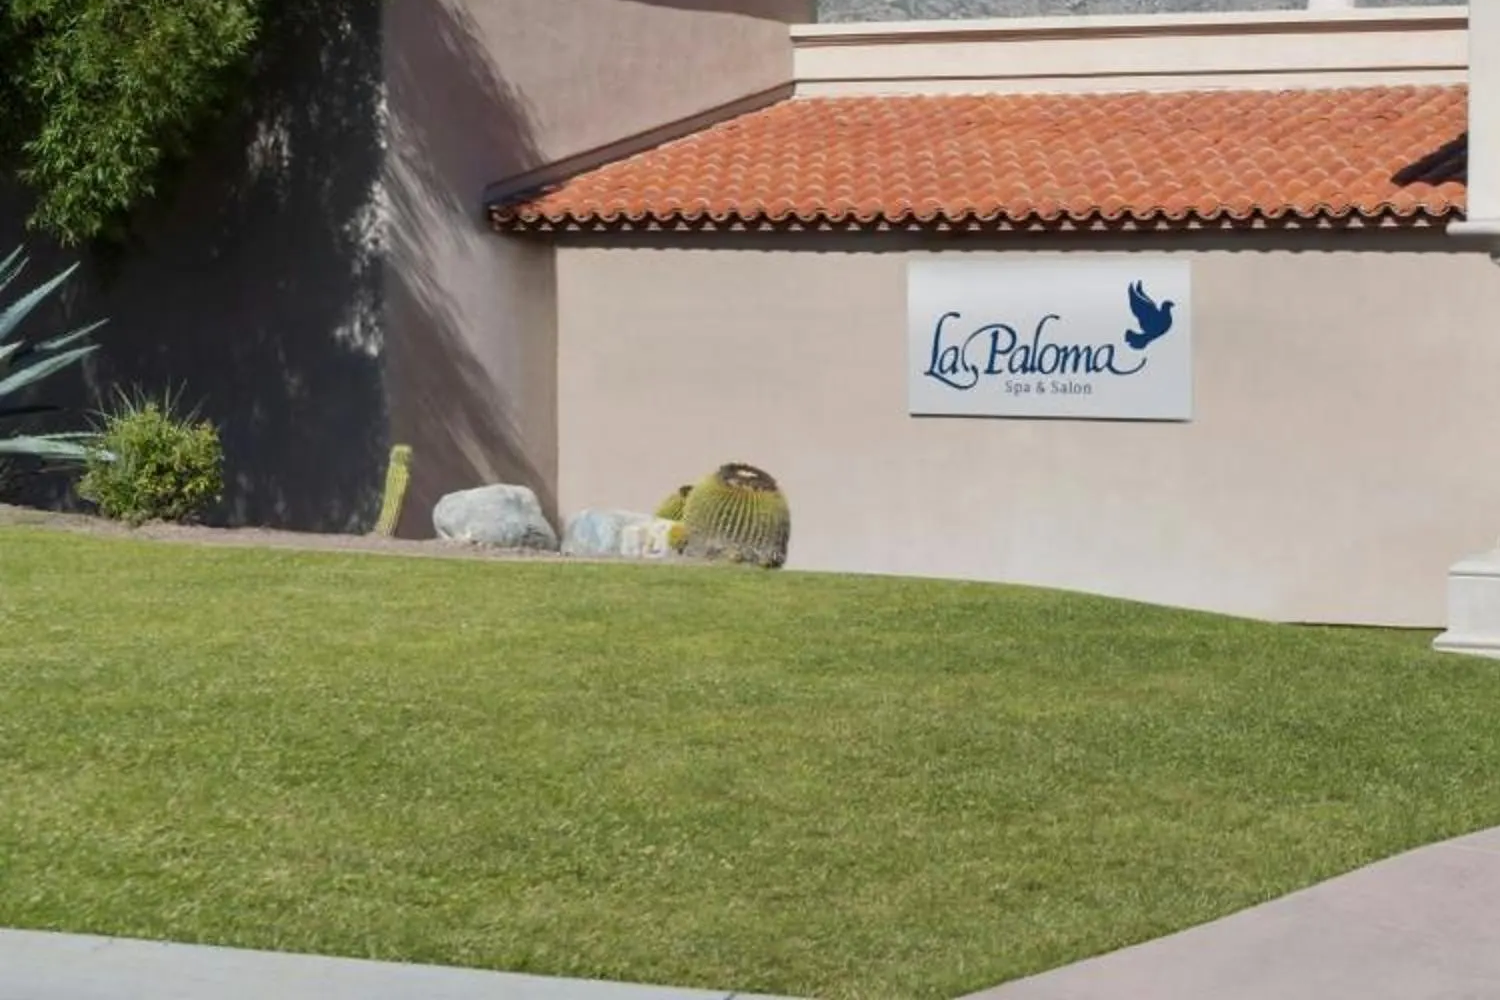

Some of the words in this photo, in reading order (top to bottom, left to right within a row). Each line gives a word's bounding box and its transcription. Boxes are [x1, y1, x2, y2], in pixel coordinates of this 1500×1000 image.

[923, 311, 979, 391] La
[961, 313, 1147, 376] Paloma
[1004, 380, 1031, 395] Spa
[1035, 380, 1046, 394] &
[1050, 379, 1092, 395] Salon
